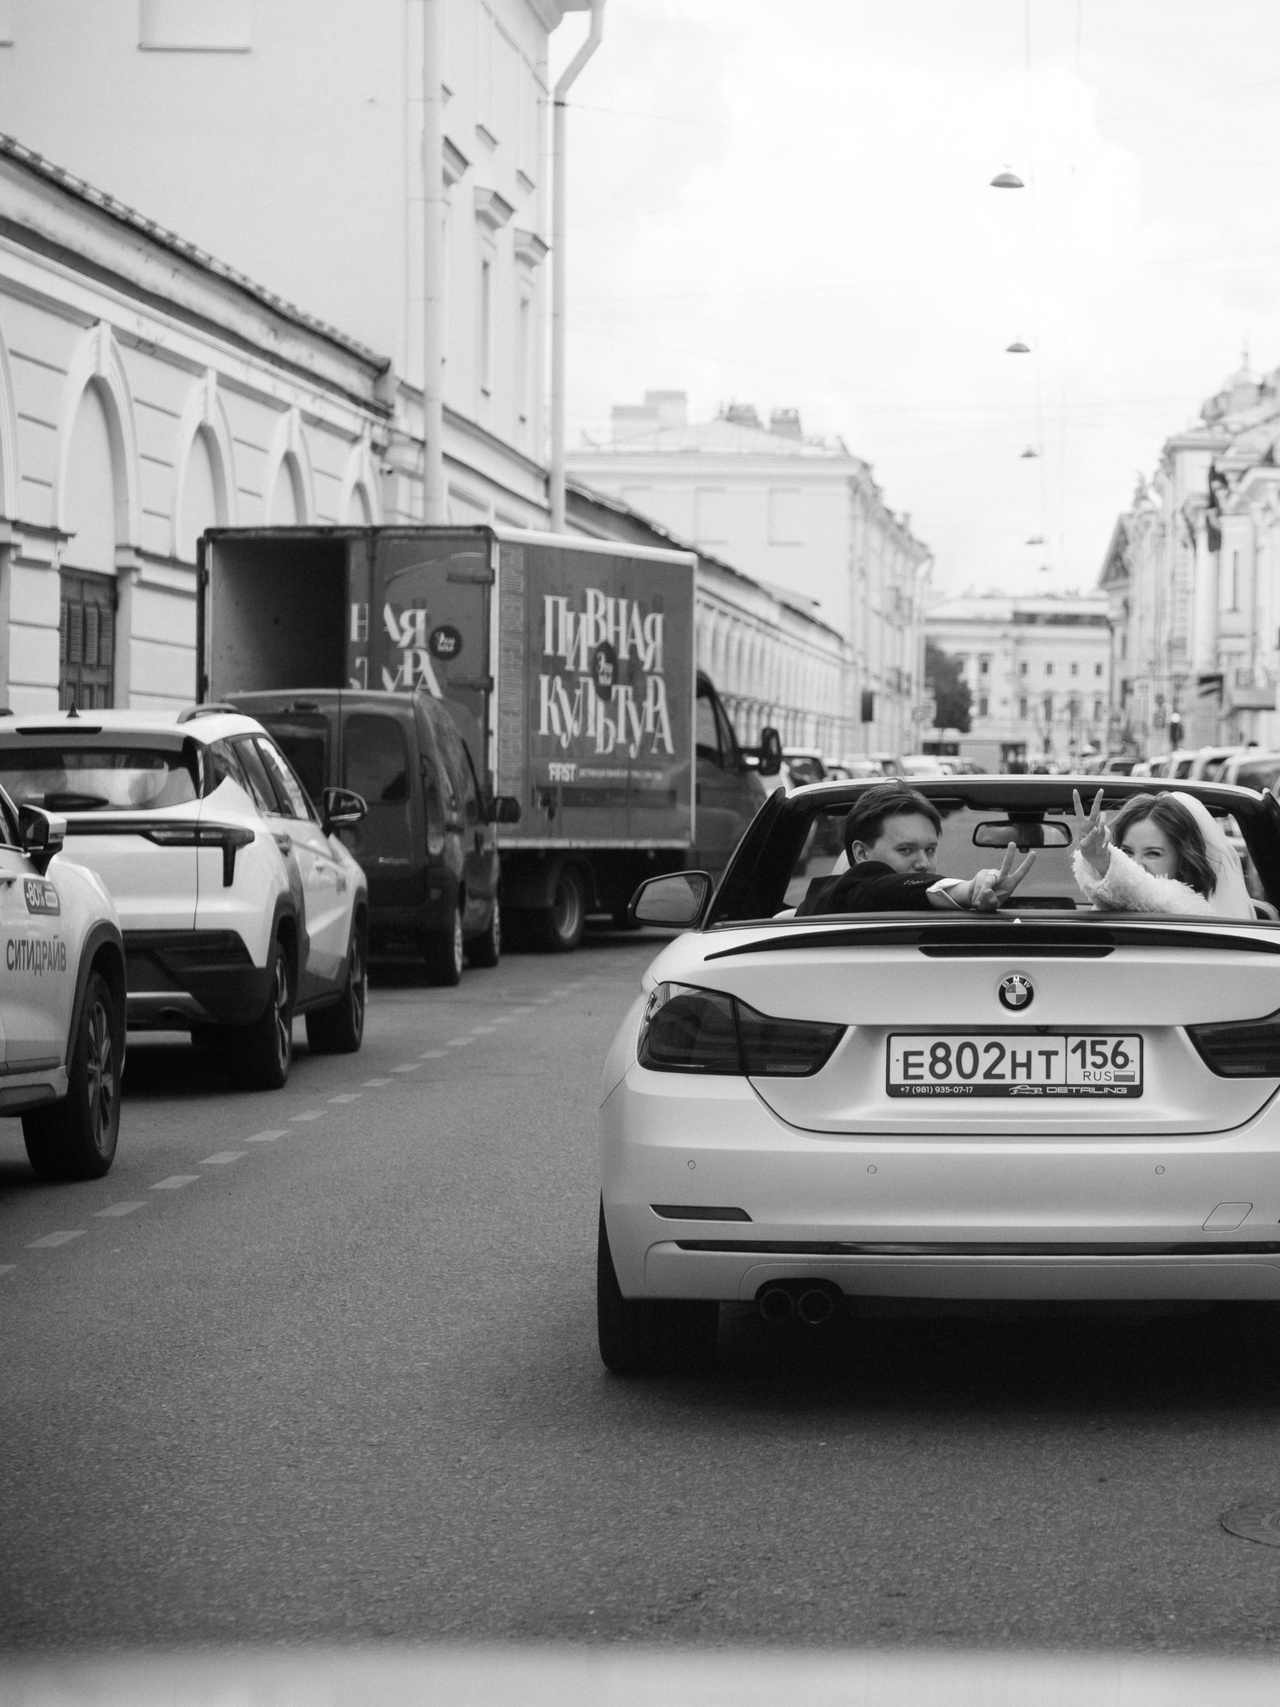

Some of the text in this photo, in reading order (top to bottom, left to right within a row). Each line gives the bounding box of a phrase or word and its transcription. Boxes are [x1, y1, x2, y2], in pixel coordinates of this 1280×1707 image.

[543, 587, 664, 673] ПИВНАЯ
[538, 674, 675, 759] КУЛЬТУРА
[6, 934, 67, 976] СИТИДРАЙВ
[1001, 976, 1032, 988] BMW
[902, 1039, 1130, 1080] Е802НТ 156
[1082, 1070, 1112, 1082] RUS
[912, 1085, 933, 1094] (981)
[935, 1086, 973, 1094] 935-07-17
